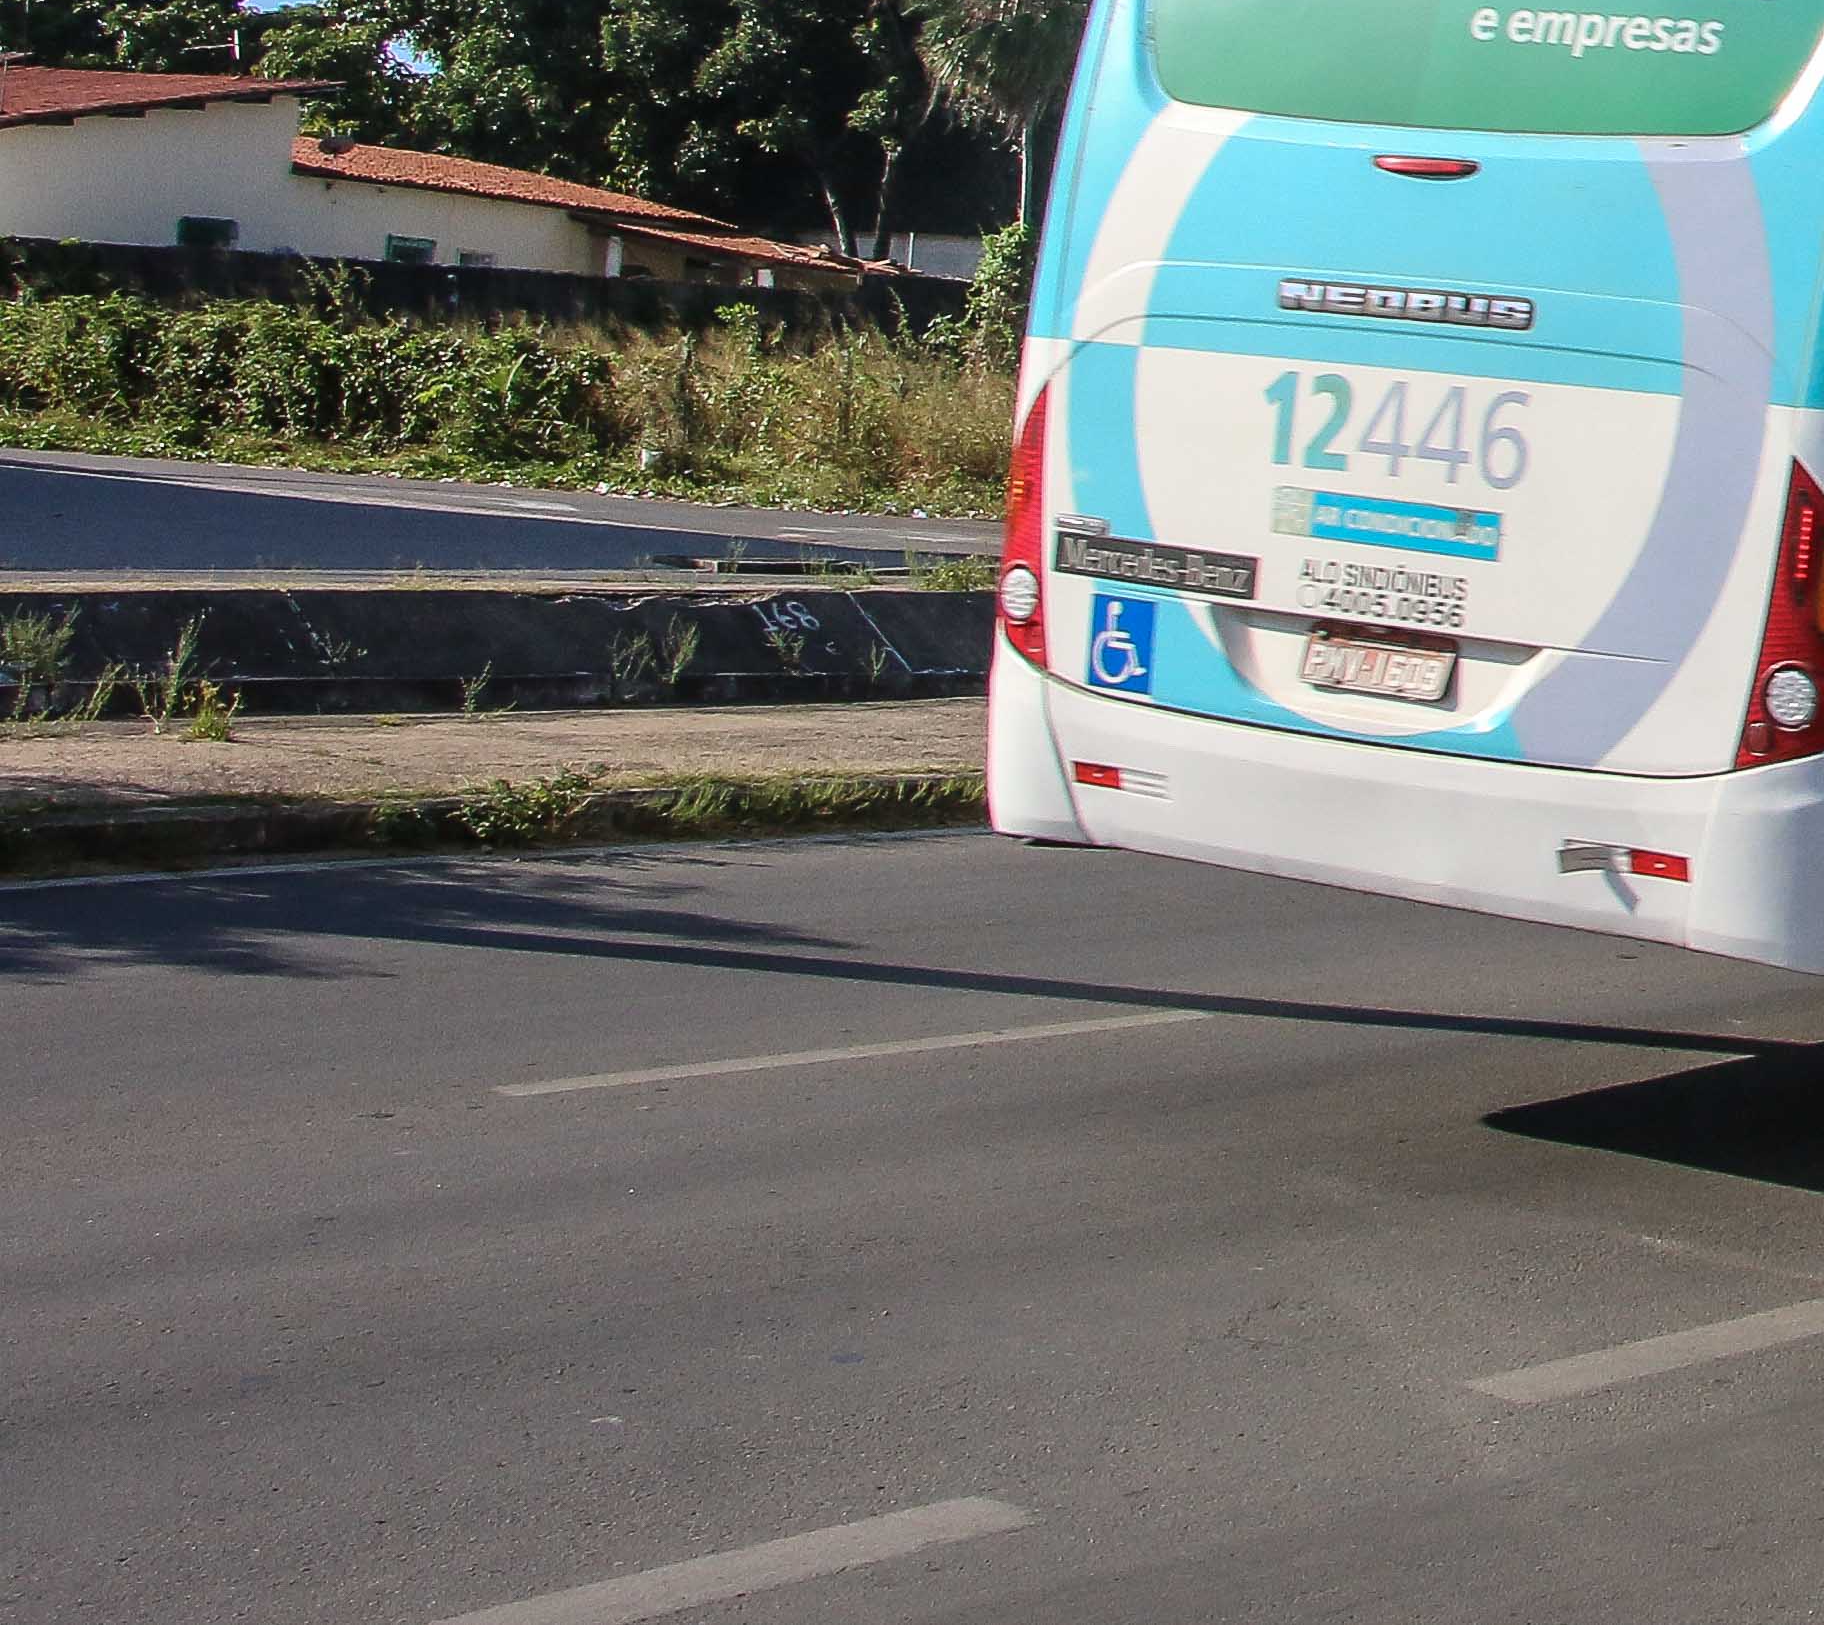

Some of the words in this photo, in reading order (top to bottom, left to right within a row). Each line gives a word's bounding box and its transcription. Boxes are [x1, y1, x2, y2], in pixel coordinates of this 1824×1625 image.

[1470, 7, 1499, 42] e
[1507, 8, 1726, 59] empresas
[1279, 280, 1533, 329] NEOBUS
[1263, 370, 1532, 490] 12446
